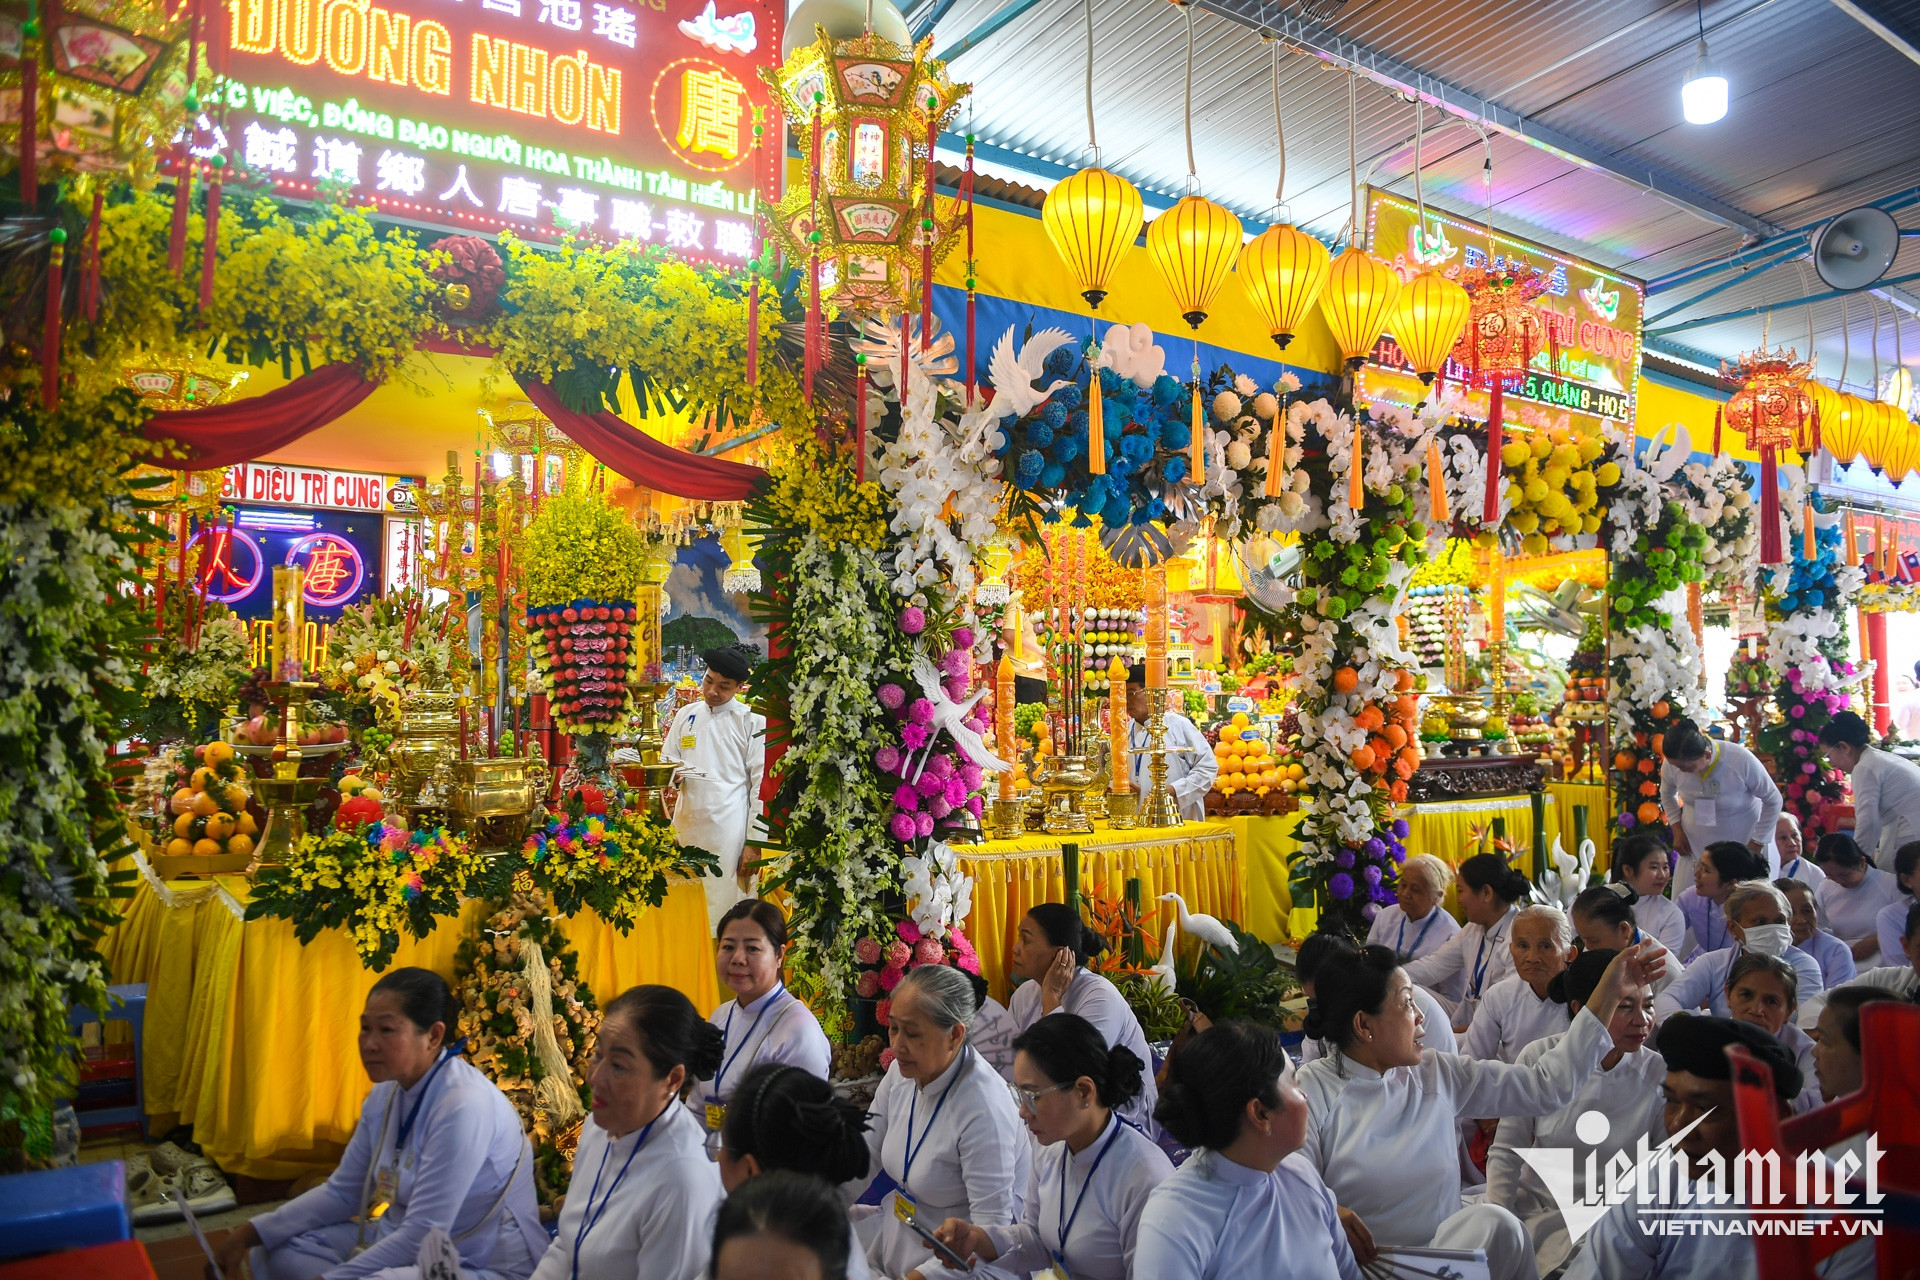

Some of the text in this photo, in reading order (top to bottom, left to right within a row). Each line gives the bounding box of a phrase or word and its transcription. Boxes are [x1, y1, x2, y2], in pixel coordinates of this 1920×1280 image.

[470, 33, 622, 134] NHƠN
[676, 69, 743, 161] 唐
[398, 119, 449, 150] ĐẠO
[452, 130, 521, 165] NGƯỜI
[526, 146, 571, 176] HOA
[573, 157, 643, 191] THÀNH
[646, 171, 688, 201] TÂM
[691, 180, 734, 211] HIẾN
[1578, 320, 1634, 363] CUNG
[253, 466, 295, 502] DIÊU
[300, 468, 331, 505] TRÌ
[334, 475, 380, 509] CUNG
[511, 870, 535, 892] 福
